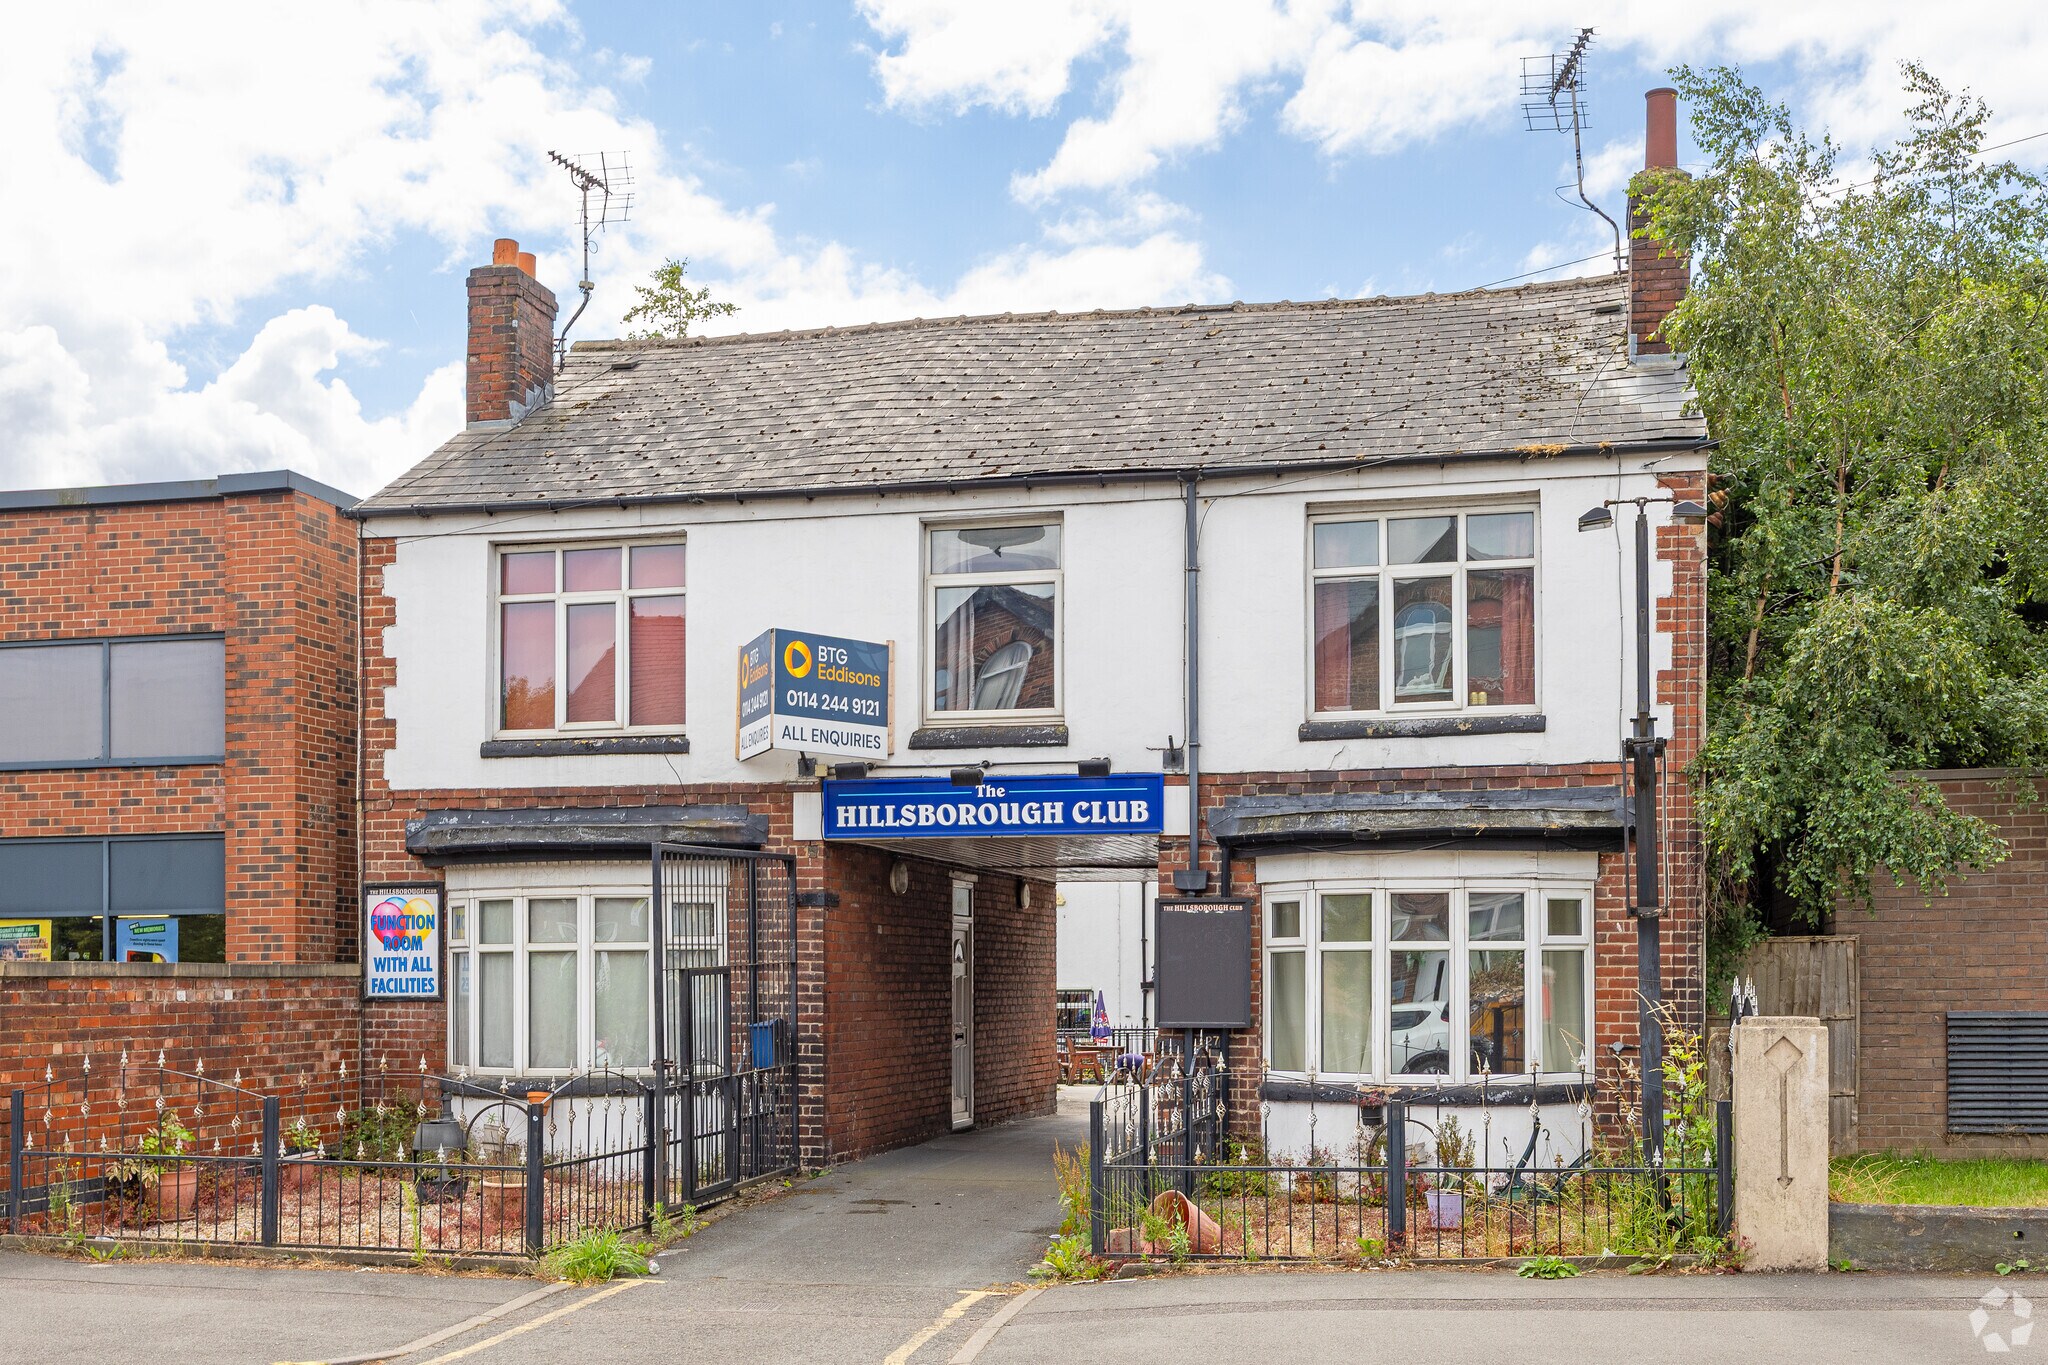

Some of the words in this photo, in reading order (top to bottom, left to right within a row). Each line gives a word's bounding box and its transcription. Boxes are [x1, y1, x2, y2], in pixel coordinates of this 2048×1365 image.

[749, 647, 759, 666] BTG
[818, 645, 848, 665] BTG
[749, 663, 769, 684] Eddisons
[817, 664, 881, 688] Eddisons
[742, 699, 751, 718] 0114
[751, 695, 760, 714] 244
[759, 690, 769, 709] 9121
[786, 690, 818, 709] 0114
[821, 694, 849, 713] 244
[852, 698, 880, 717] 9121
[741, 735, 749, 751] ALL
[748, 725, 769, 747] ENQUIRIES
[782, 725, 808, 742] ALL
[811, 728, 881, 750] ENQUIRIES
[975, 784, 1006, 799] The
[836, 801, 1064, 828] HILLSBOROUGH
[1071, 800, 1150, 825] CLUB
[1174, 904, 1229, 912] HILLSBOROUGH
[370, 914, 436, 931] FUNCTION
[383, 935, 423, 952] ROOM
[373, 957, 408, 973] WITH
[411, 956, 433, 972] ALL
[371, 977, 435, 994] FACILITIES
